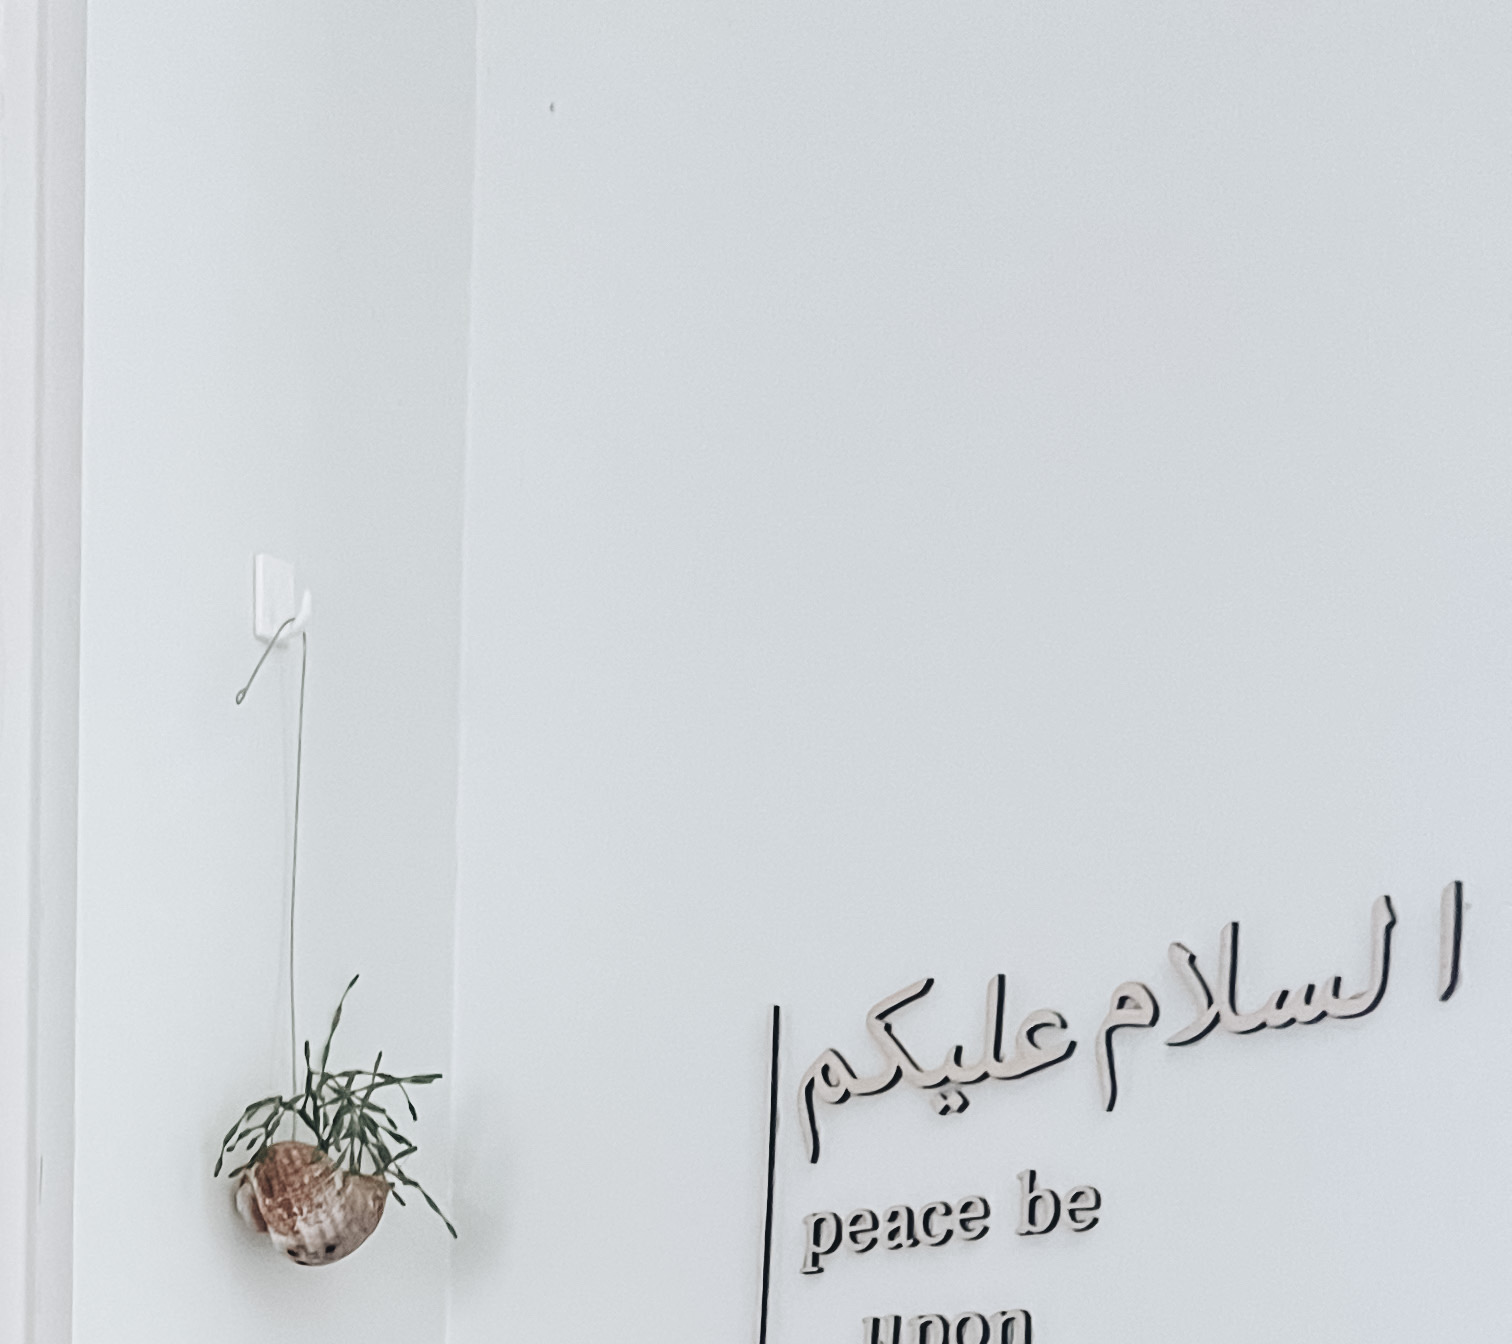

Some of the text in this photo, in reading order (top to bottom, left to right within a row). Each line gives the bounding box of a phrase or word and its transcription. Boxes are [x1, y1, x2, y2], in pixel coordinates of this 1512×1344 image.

[798, 973, 1078, 1164] عليكم
[802, 1170, 1102, 1275] peace be
